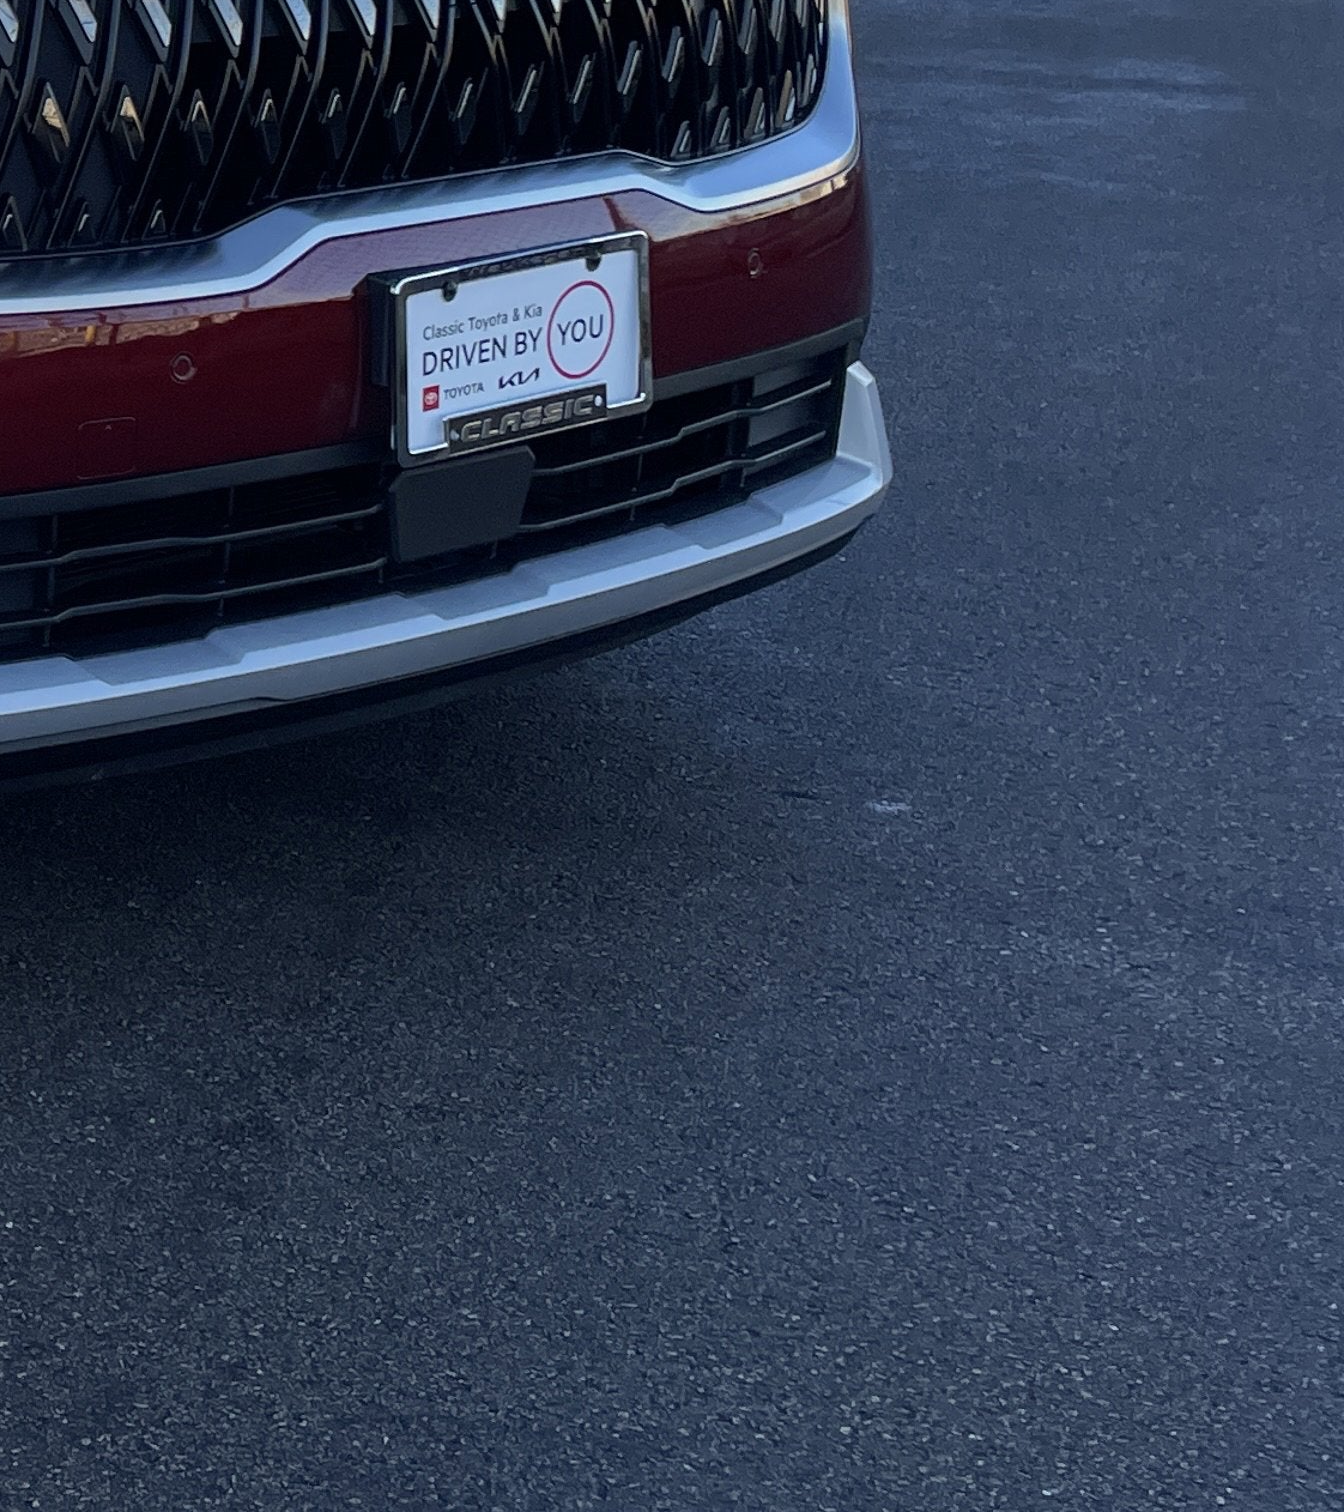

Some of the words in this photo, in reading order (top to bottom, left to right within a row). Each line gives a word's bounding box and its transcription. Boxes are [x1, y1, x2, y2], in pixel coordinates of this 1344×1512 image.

[423, 320, 465, 341] Classic
[468, 312, 508, 331] Toyota
[512, 307, 520, 321] &
[524, 304, 543, 319] Kia
[422, 334, 507, 376] DRIVEN
[514, 327, 543, 356] BY
[557, 314, 604, 345] YOU
[443, 382, 485, 400] TOYOTA
[461, 394, 595, 442] CLASSIC
